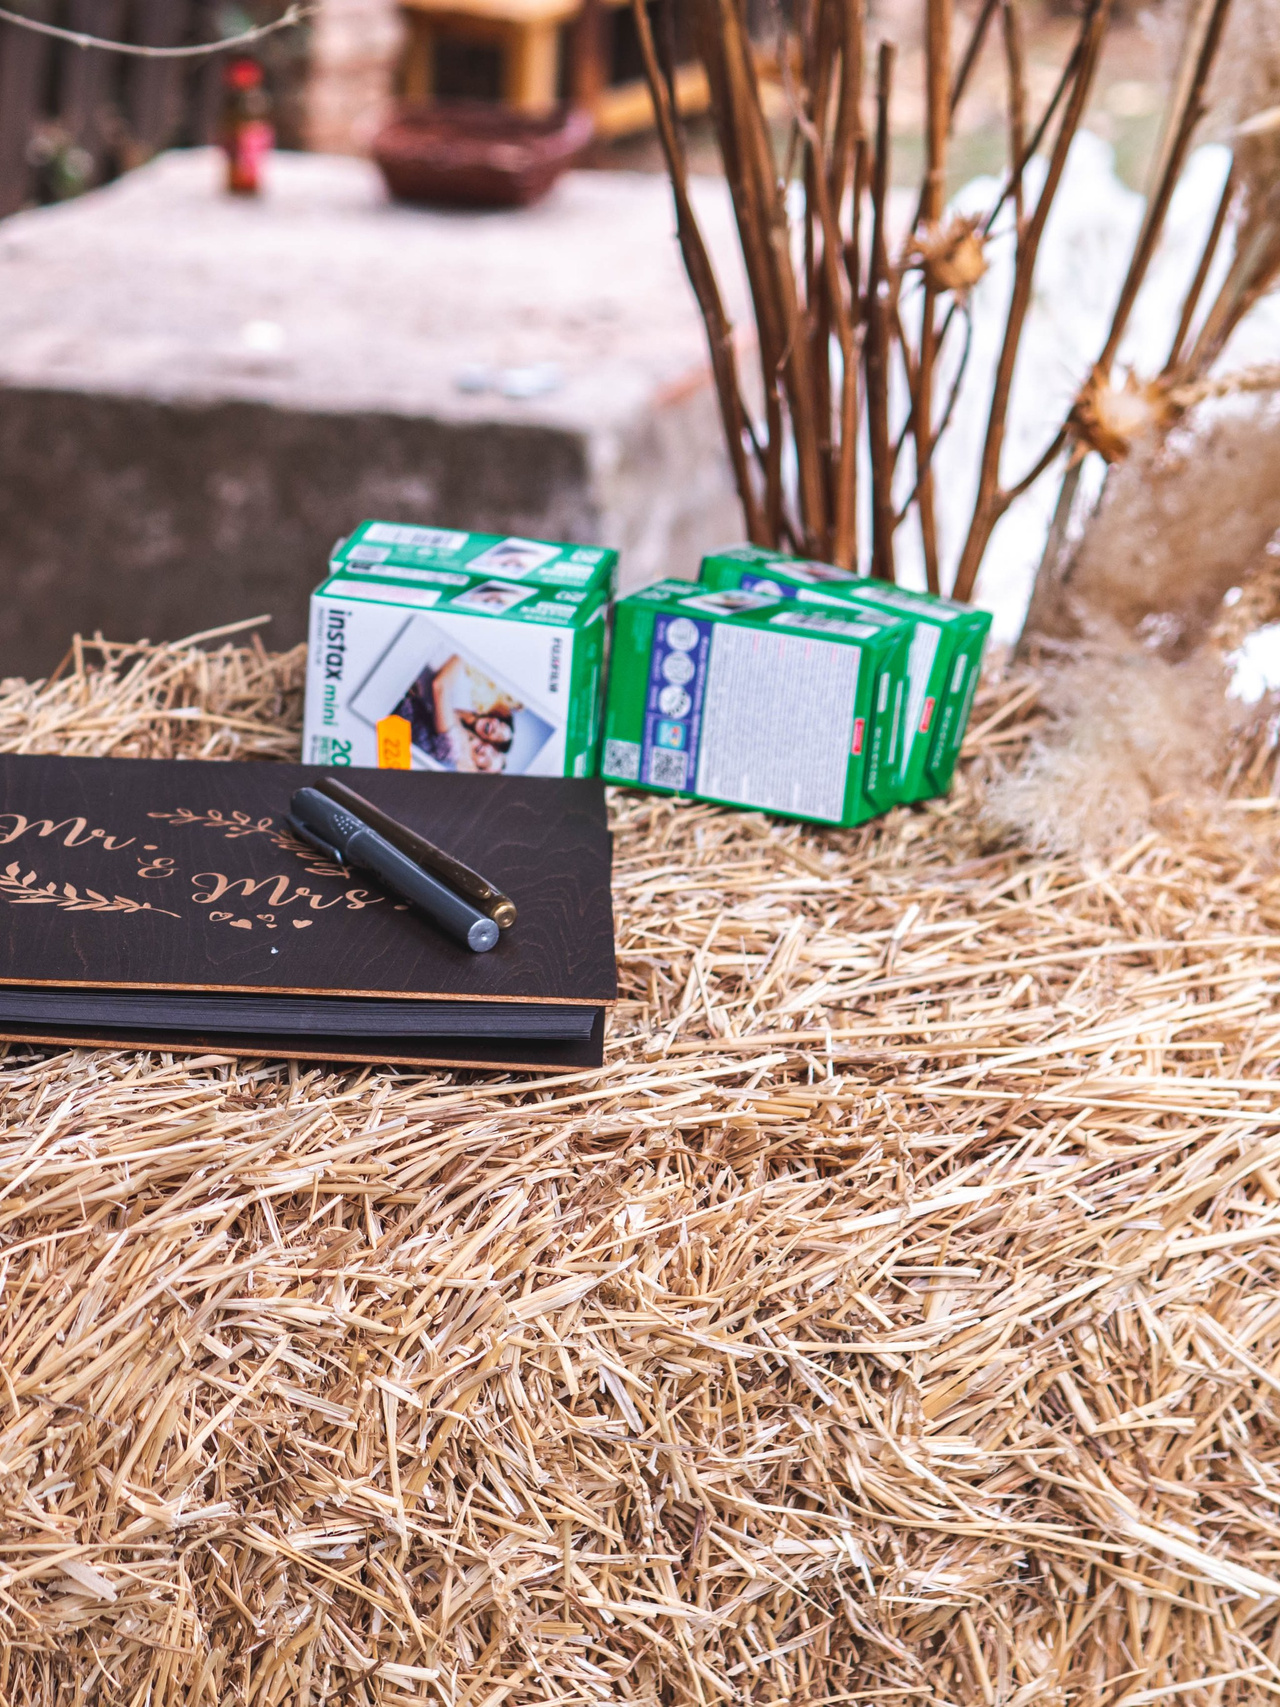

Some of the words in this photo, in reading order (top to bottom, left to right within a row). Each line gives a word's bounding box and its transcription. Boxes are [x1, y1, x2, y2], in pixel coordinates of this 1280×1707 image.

[324, 608, 352, 681] instax
[323, 684, 339, 727] mini
[331, 739, 352, 768] 20
[137, 856, 180, 879] &
[191, 871, 409, 911] Mrs.
